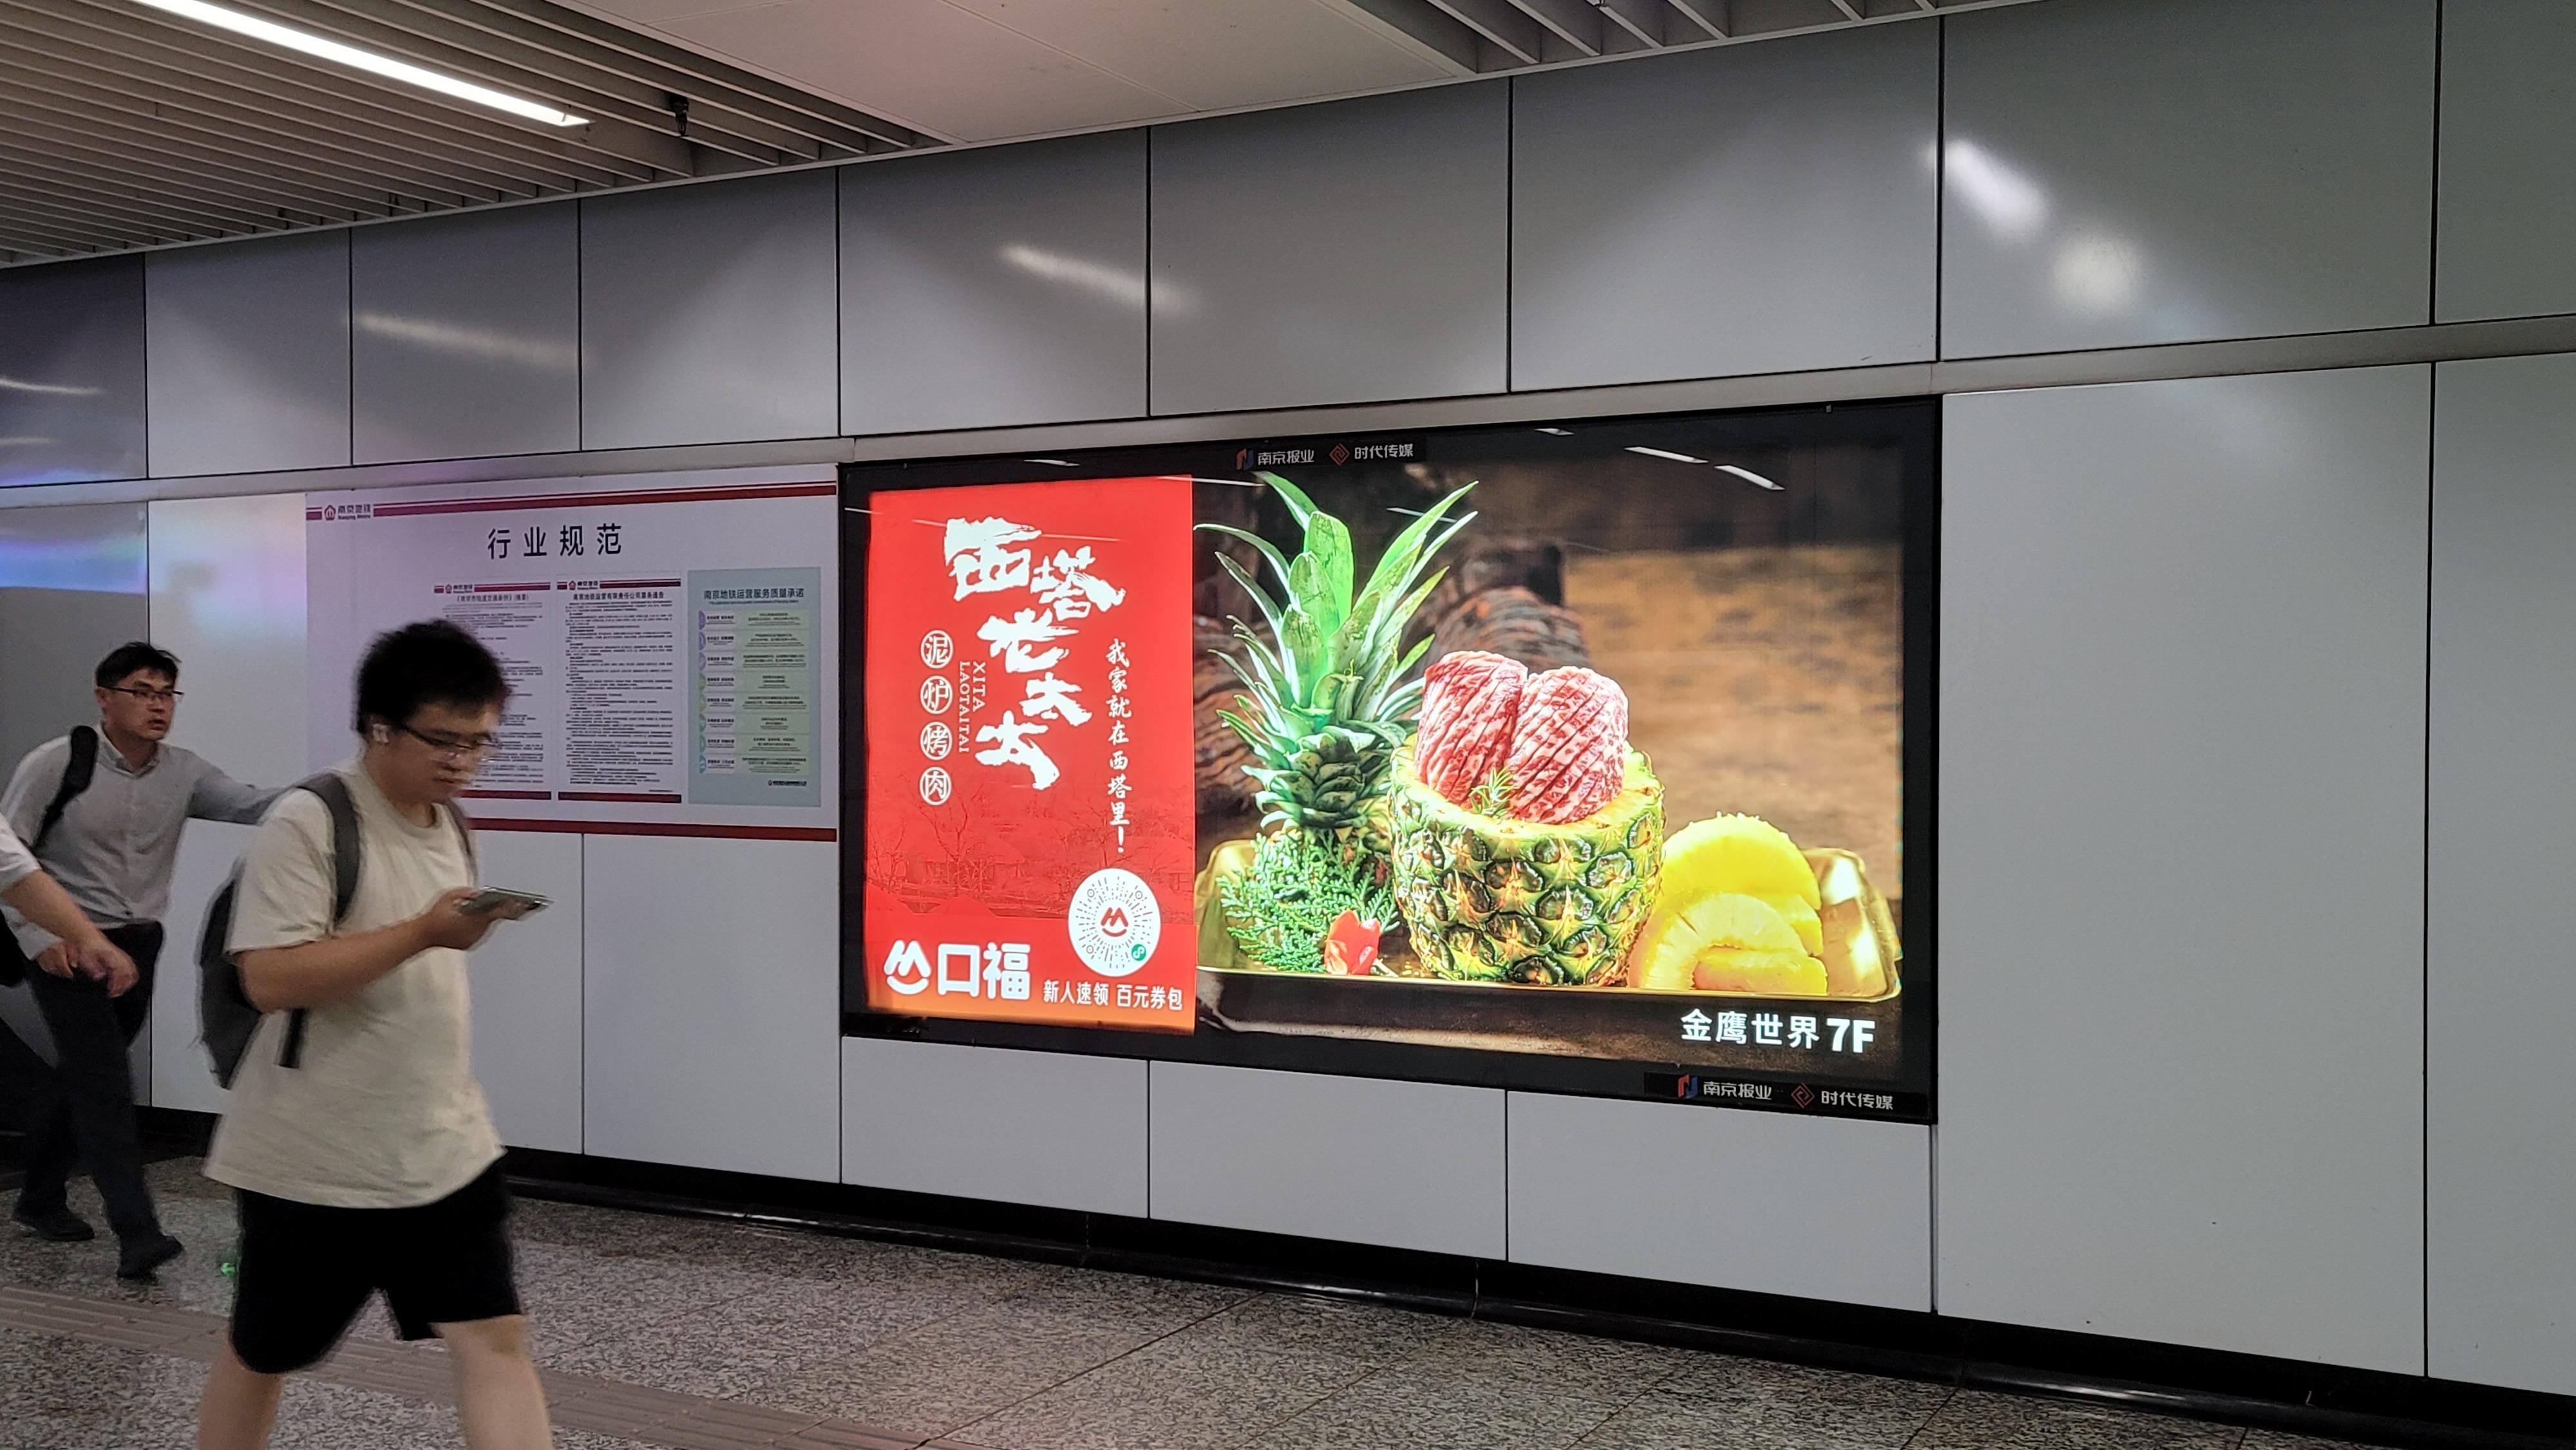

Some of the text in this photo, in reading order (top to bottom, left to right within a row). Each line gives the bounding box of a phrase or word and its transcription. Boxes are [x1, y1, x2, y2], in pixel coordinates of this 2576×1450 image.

[1257, 443, 1414, 466] 南京报业 时代传媒
[488, 522, 623, 560] 行业规范
[943, 516, 1126, 791] 西塔老太太
[958, 661, 971, 753] LAOTAITAI
[972, 661, 987, 712] XITA
[922, 632, 952, 804] 泥炉烤肉
[1106, 639, 1132, 853] 我家就在西塔里！
[1043, 979, 1183, 1011] 新人速领 百元券包
[1703, 1081, 1894, 1111] 南京报业 时代传媒
